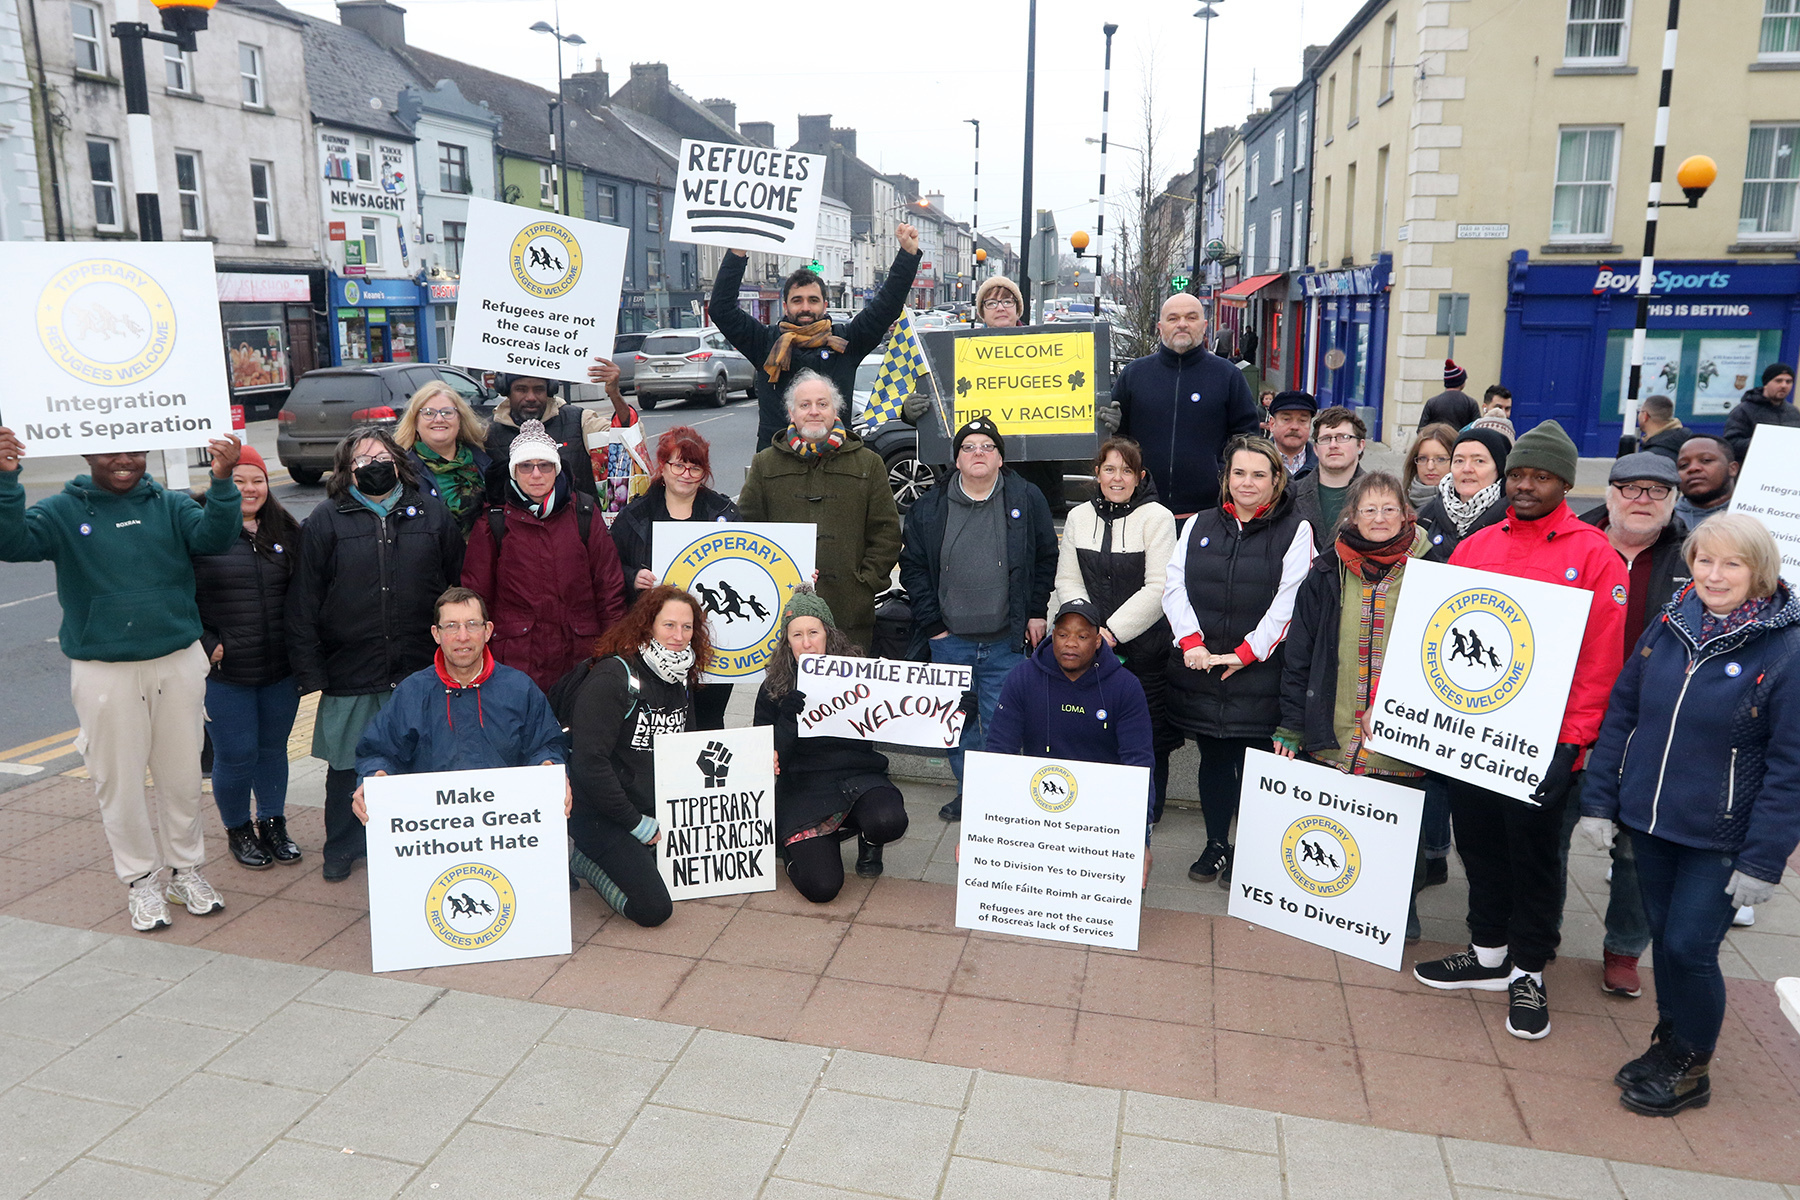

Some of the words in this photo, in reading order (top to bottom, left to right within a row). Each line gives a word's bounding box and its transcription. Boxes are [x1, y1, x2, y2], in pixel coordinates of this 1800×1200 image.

[688, 143, 810, 181] REFUGEES
[331, 190, 406, 211] NEWSAGENT
[682, 178, 803, 213] WELCOME
[524, 224, 573, 244] TIPPERARY
[54, 264, 148, 293] TIPPERARY
[514, 255, 543, 295] REFUGEES
[544, 265, 578, 296] WELCOME
[363, 291, 385, 300] Keane's
[430, 284, 456, 298] TASTY
[482, 299, 545, 319] Refugees
[548, 312, 570, 323] are
[573, 315, 596, 328] not
[1648, 304, 1673, 316] HIS
[1674, 304, 1689, 316] IS
[497, 318, 519, 332] the
[523, 325, 560, 338] cause
[564, 329, 580, 341] of
[45, 325, 113, 381] REFUGEES
[117, 320, 169, 380] WELCOME
[506, 352, 561, 370] Services
[544, 341, 570, 356] lack
[574, 346, 589, 358] of
[976, 344, 1064, 360] WELCOME
[976, 375, 1063, 390] REFUGEES
[46, 391, 187, 414] Integration
[1001, 408, 1014, 421] V
[1020, 404, 1093, 421] RACISM!
[25, 422, 73, 440] Not
[80, 415, 212, 440] Separation
[1760, 483, 1800, 497] Integra
[1736, 502, 1764, 514] Make
[1766, 507, 1800, 520] Roscre
[683, 537, 782, 568] TIPPERARY
[1446, 593, 1523, 625] TIPPERARY
[801, 655, 854, 678] CÉAD
[855, 660, 901, 682] MÍLE
[906, 663, 971, 688] FÁILTE
[1426, 641, 1464, 706] REFUGEES
[1466, 660, 1526, 708] WELCOME
[801, 683, 871, 730] 100,000
[1061, 704, 1086, 714] LOMA
[1384, 698, 1430, 725] Céad
[1434, 712, 1476, 740] Míle
[1481, 727, 1540, 759] Fáilte
[1372, 720, 1430, 752] Roimh
[1436, 743, 1457, 760] ar
[1460, 751, 1540, 787] gCairde
[1038, 767, 1070, 778] TIPPERARY
[436, 787, 496, 806] Make
[666, 790, 765, 828] TIPPERARY
[1032, 786, 1053, 810] REFUGEES
[1053, 791, 1076, 812] WELCOME
[1259, 776, 1287, 796] NO
[1292, 785, 1313, 802] to
[1318, 791, 1399, 825] Division
[390, 816, 475, 834] Roscrea
[482, 809, 542, 826] Great
[984, 813, 1041, 827] Integration
[1043, 820, 1062, 829] Not
[1064, 822, 1121, 835] Separation
[1296, 818, 1350, 842] TIPPERARY
[394, 837, 484, 858] without
[490, 834, 539, 850] Hate
[666, 819, 774, 858] ANTI-RACISM
[967, 834, 995, 844] Make
[997, 837, 1036, 848] Roscrea
[1038, 841, 1066, 852] Great
[1068, 844, 1109, 857] without
[1112, 850, 1136, 860] Hate
[438, 866, 500, 888] TIPPERARY
[672, 848, 764, 888] NETWORK
[974, 857, 988, 866] No
[990, 858, 1002, 868] to
[1004, 860, 1044, 872] Division
[1047, 865, 1064, 875] Yes
[1066, 867, 1078, 876] to
[1080, 869, 1126, 884] Diversity
[1284, 847, 1317, 892] REFUGEES
[1317, 864, 1356, 894] WELCOME
[964, 878, 989, 889] Céad
[992, 880, 1014, 892] Míle
[1016, 882, 1044, 896] Fáilte
[1046, 888, 1078, 900] Roimh
[1080, 892, 1092, 901] ar
[1094, 894, 1133, 906] Gcairde
[431, 910, 472, 946] REFUGEES
[474, 902, 511, 946] WELCOME
[978, 914, 991, 922] of
[1036, 920, 1056, 931] lack
[1059, 922, 1071, 932] of
[1072, 925, 1114, 938] Services
[980, 902, 1025, 916] Refugees
[1027, 909, 1044, 918] are
[1046, 910, 1064, 920] not
[1066, 912, 1083, 923] the
[1086, 916, 1114, 927] cause
[1241, 883, 1274, 906] YES
[1279, 896, 1299, 914] to
[1304, 903, 1392, 946] Diversity
